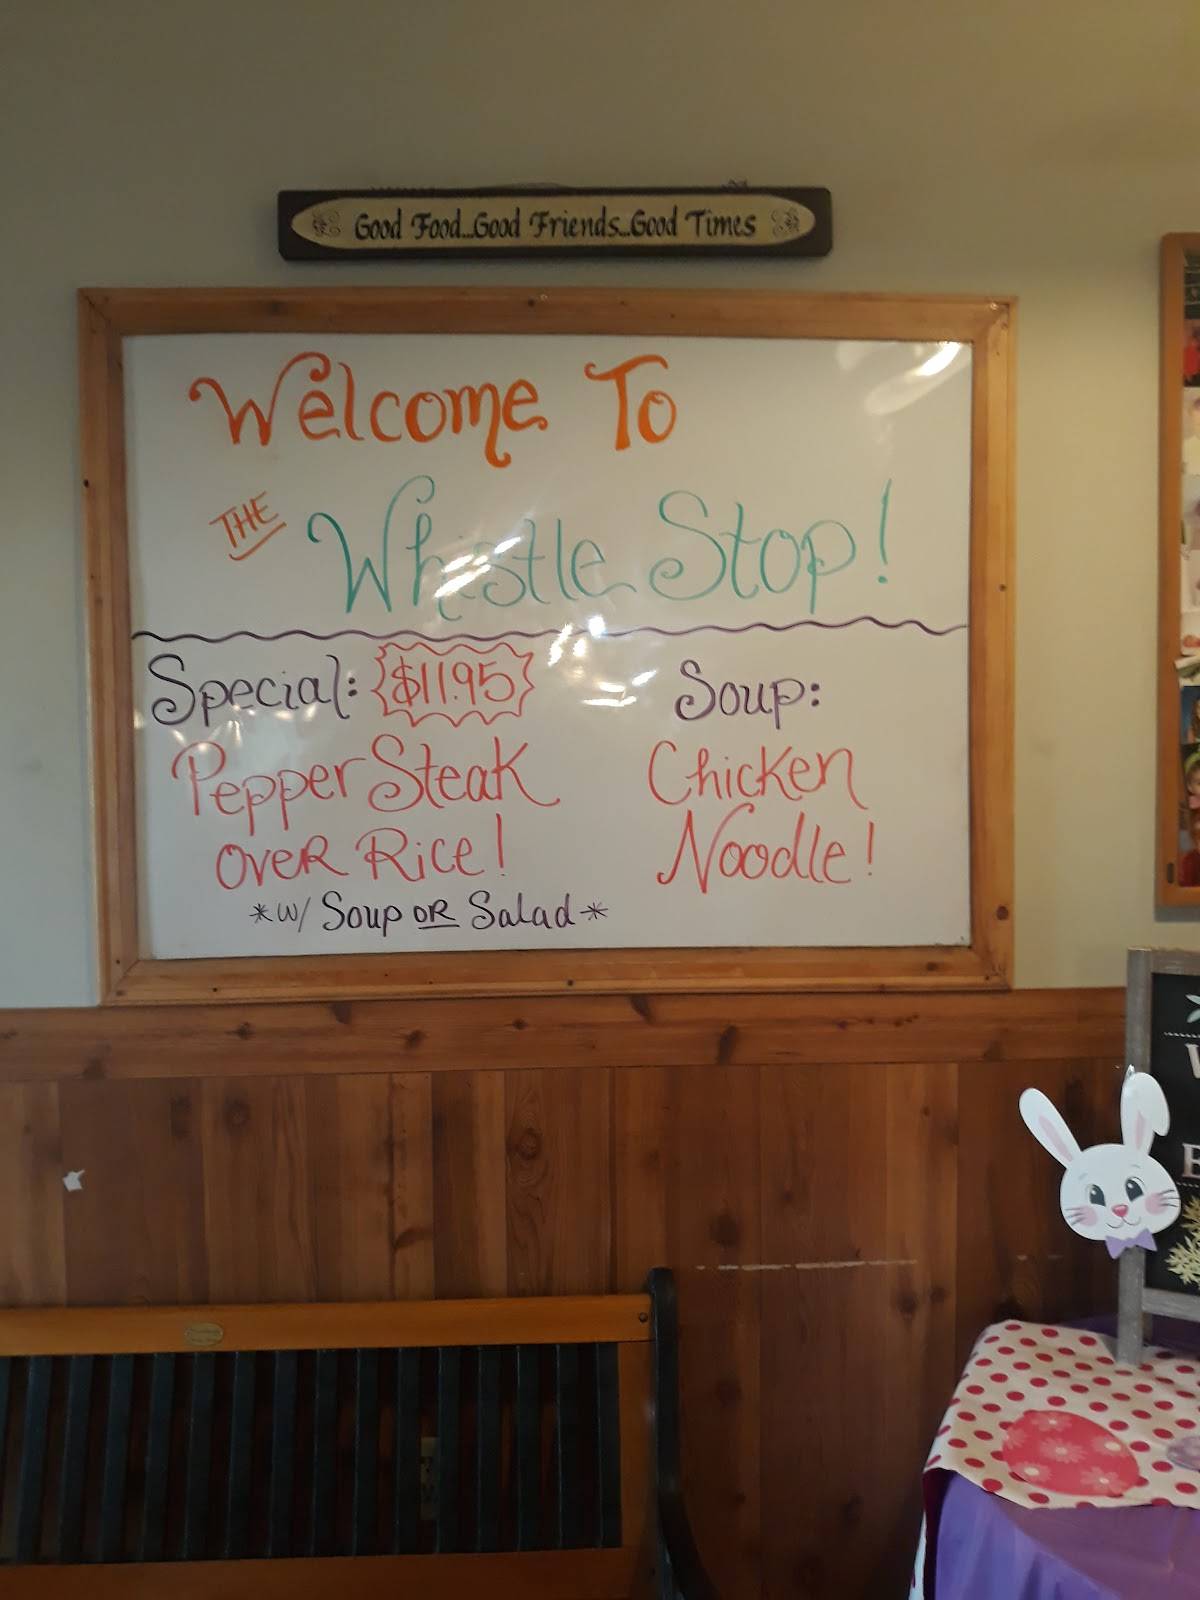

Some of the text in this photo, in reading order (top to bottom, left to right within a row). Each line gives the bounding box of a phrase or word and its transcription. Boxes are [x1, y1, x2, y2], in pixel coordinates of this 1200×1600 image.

[354, 207, 402, 241] Good
[684, 208, 757, 237] Times
[189, 352, 677, 468] Welcome To
[209, 491, 283, 553] THE
[147, 653, 516, 727] Special: $11.95
[675, 659, 821, 730] Soup:
[171, 741, 366, 835] Pepper
[321, 890, 403, 938] Soup
